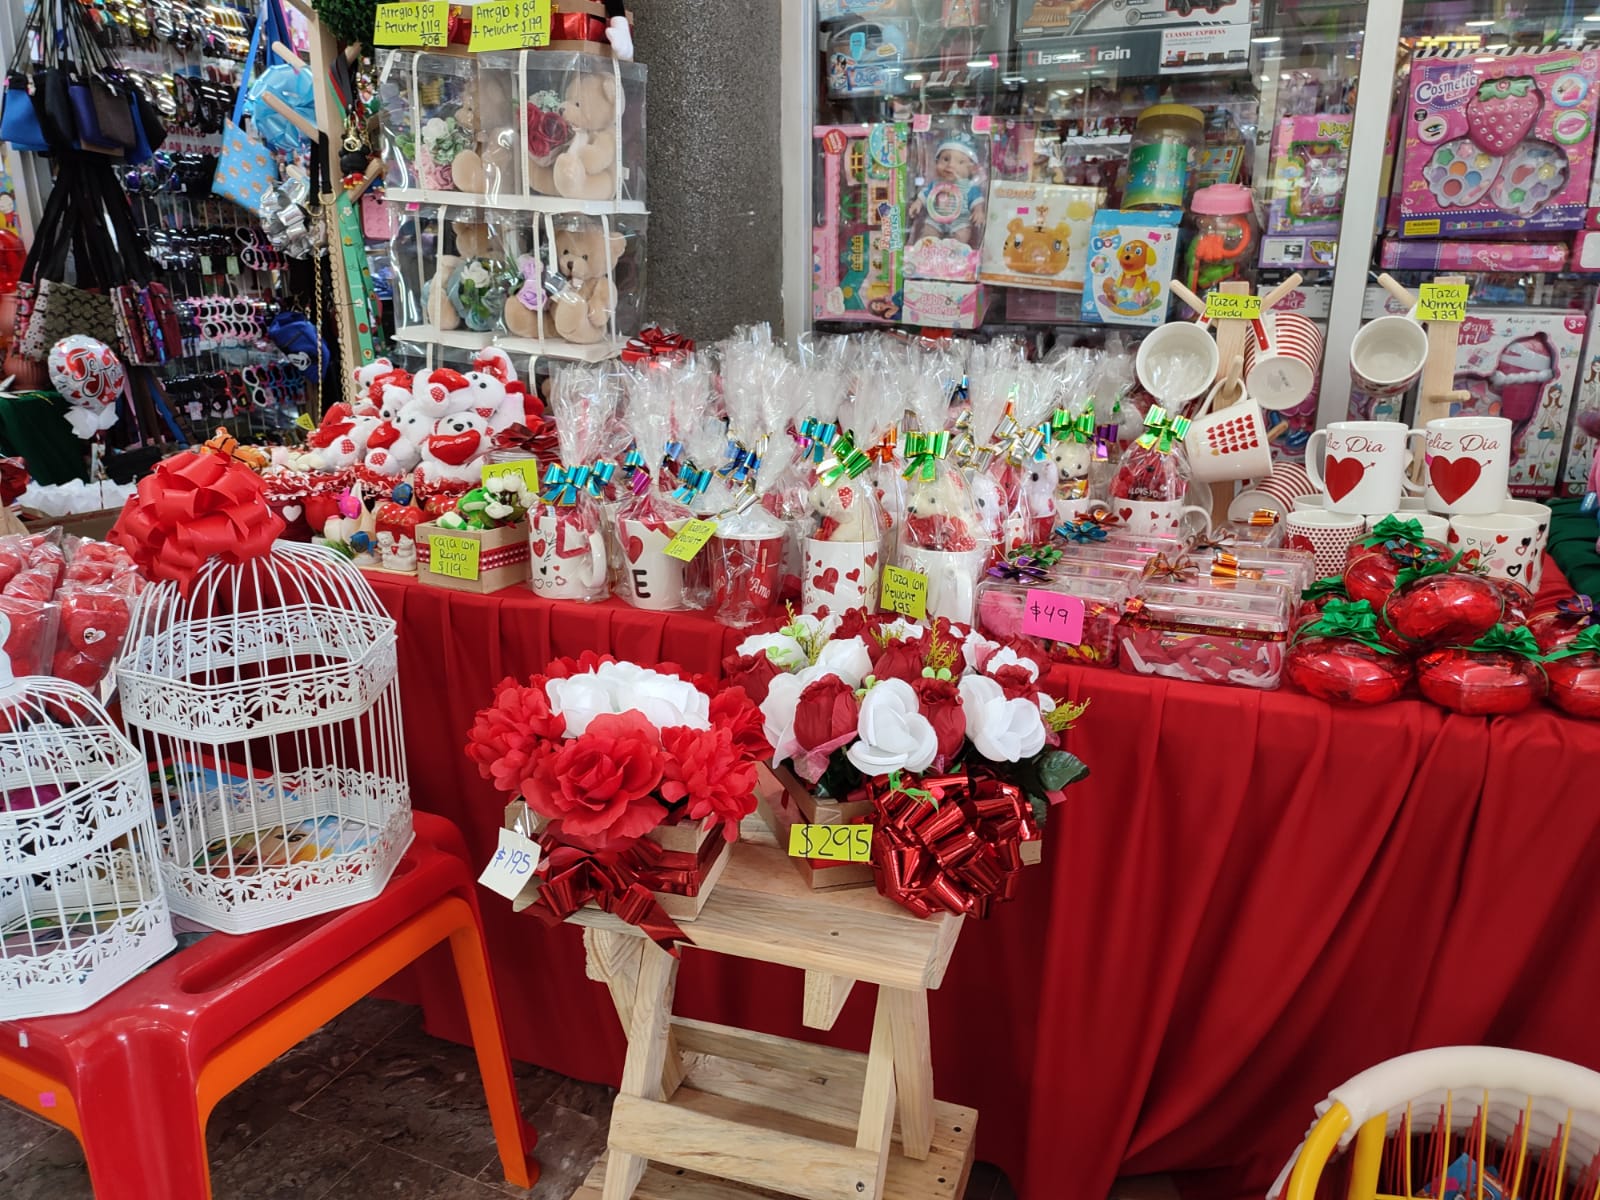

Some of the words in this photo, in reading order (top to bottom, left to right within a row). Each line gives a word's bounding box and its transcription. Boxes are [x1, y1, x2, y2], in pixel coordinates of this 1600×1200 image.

[381, 6, 413, 20] Arreglo
[476, 6, 511, 23] Arreglo
[385, 21, 418, 33] Peluche
[483, 23, 519, 37] Peluche
[1416, 73, 1478, 104] Cosmetic
[1209, 295, 1238, 307] Taza
[1427, 287, 1462, 299] Taza
[1432, 311, 1459, 320] $39
[1568, 319, 1584, 330] 3+
[1345, 435, 1386, 453] Dia
[1459, 434, 1500, 453] Dia
[887, 568, 909, 589] Taza
[1030, 600, 1069, 625] $49
[799, 824, 870, 861] $295
[494, 846, 531, 875] $195
